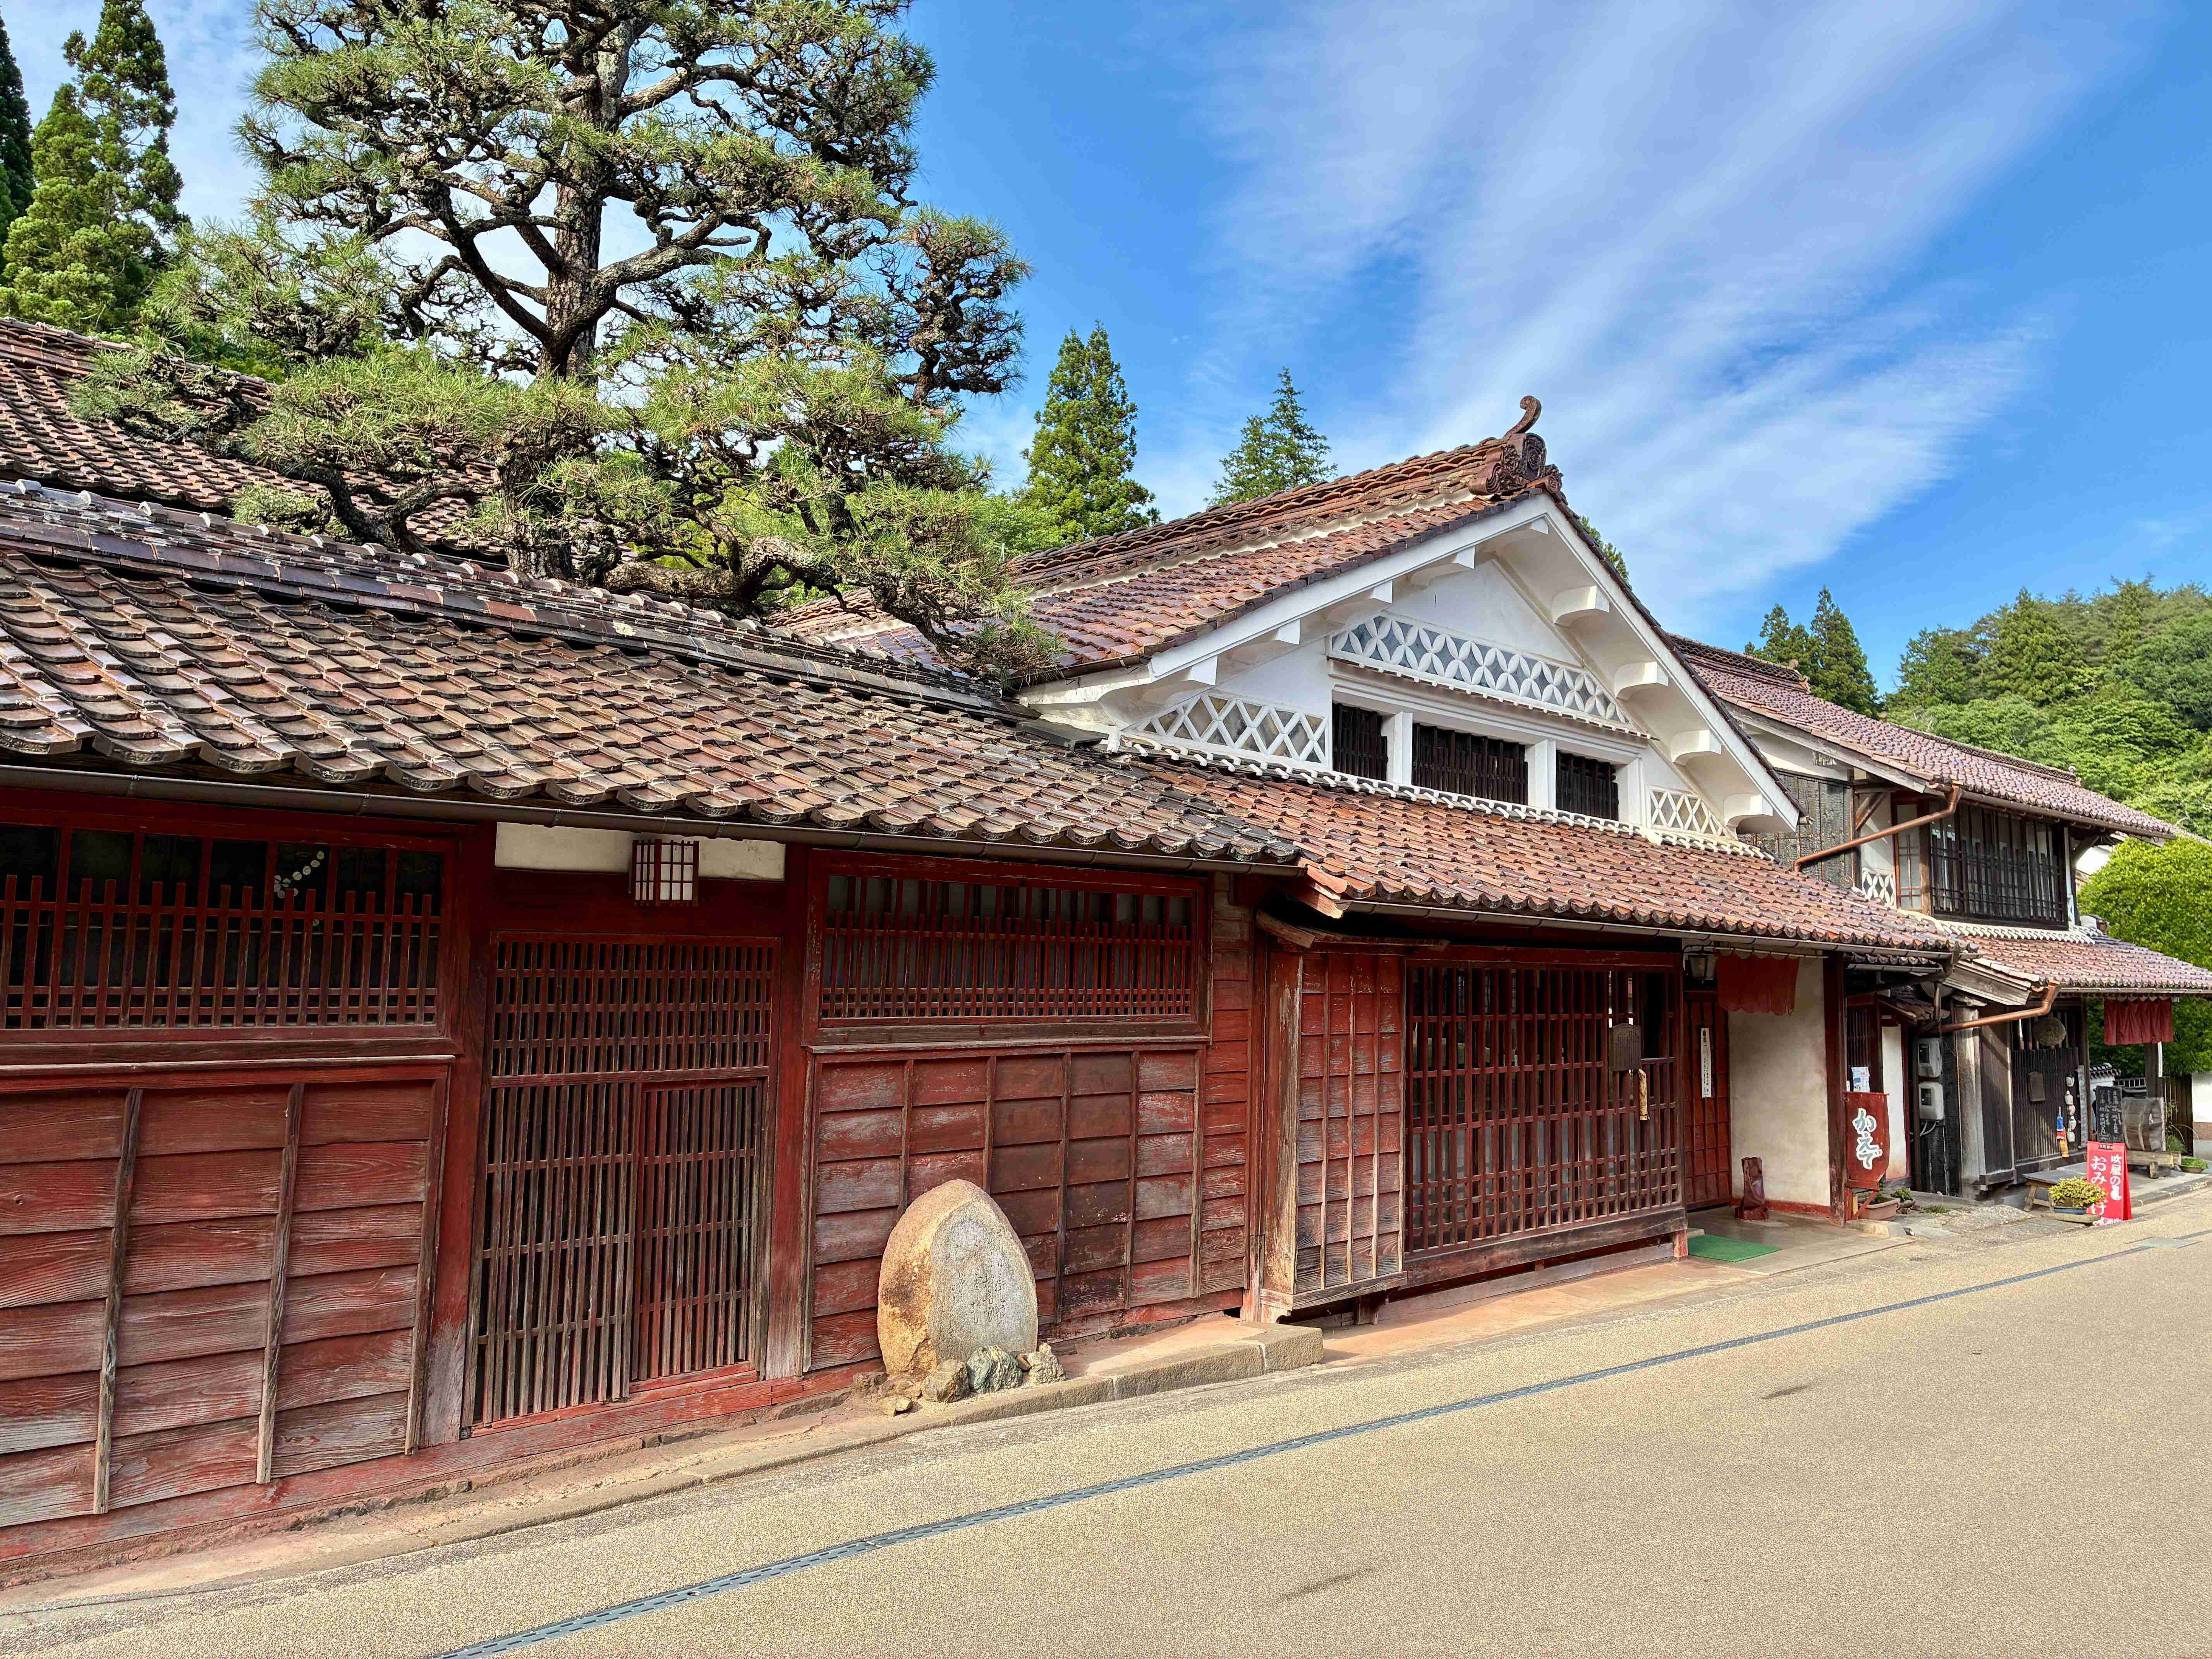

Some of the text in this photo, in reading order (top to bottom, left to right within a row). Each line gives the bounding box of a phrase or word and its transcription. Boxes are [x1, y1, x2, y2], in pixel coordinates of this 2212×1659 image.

[1852, 1108, 1882, 1170] かえで
[2090, 1156, 2108, 1215] おみげ
[2110, 1154, 2122, 1185] 吹屋の
